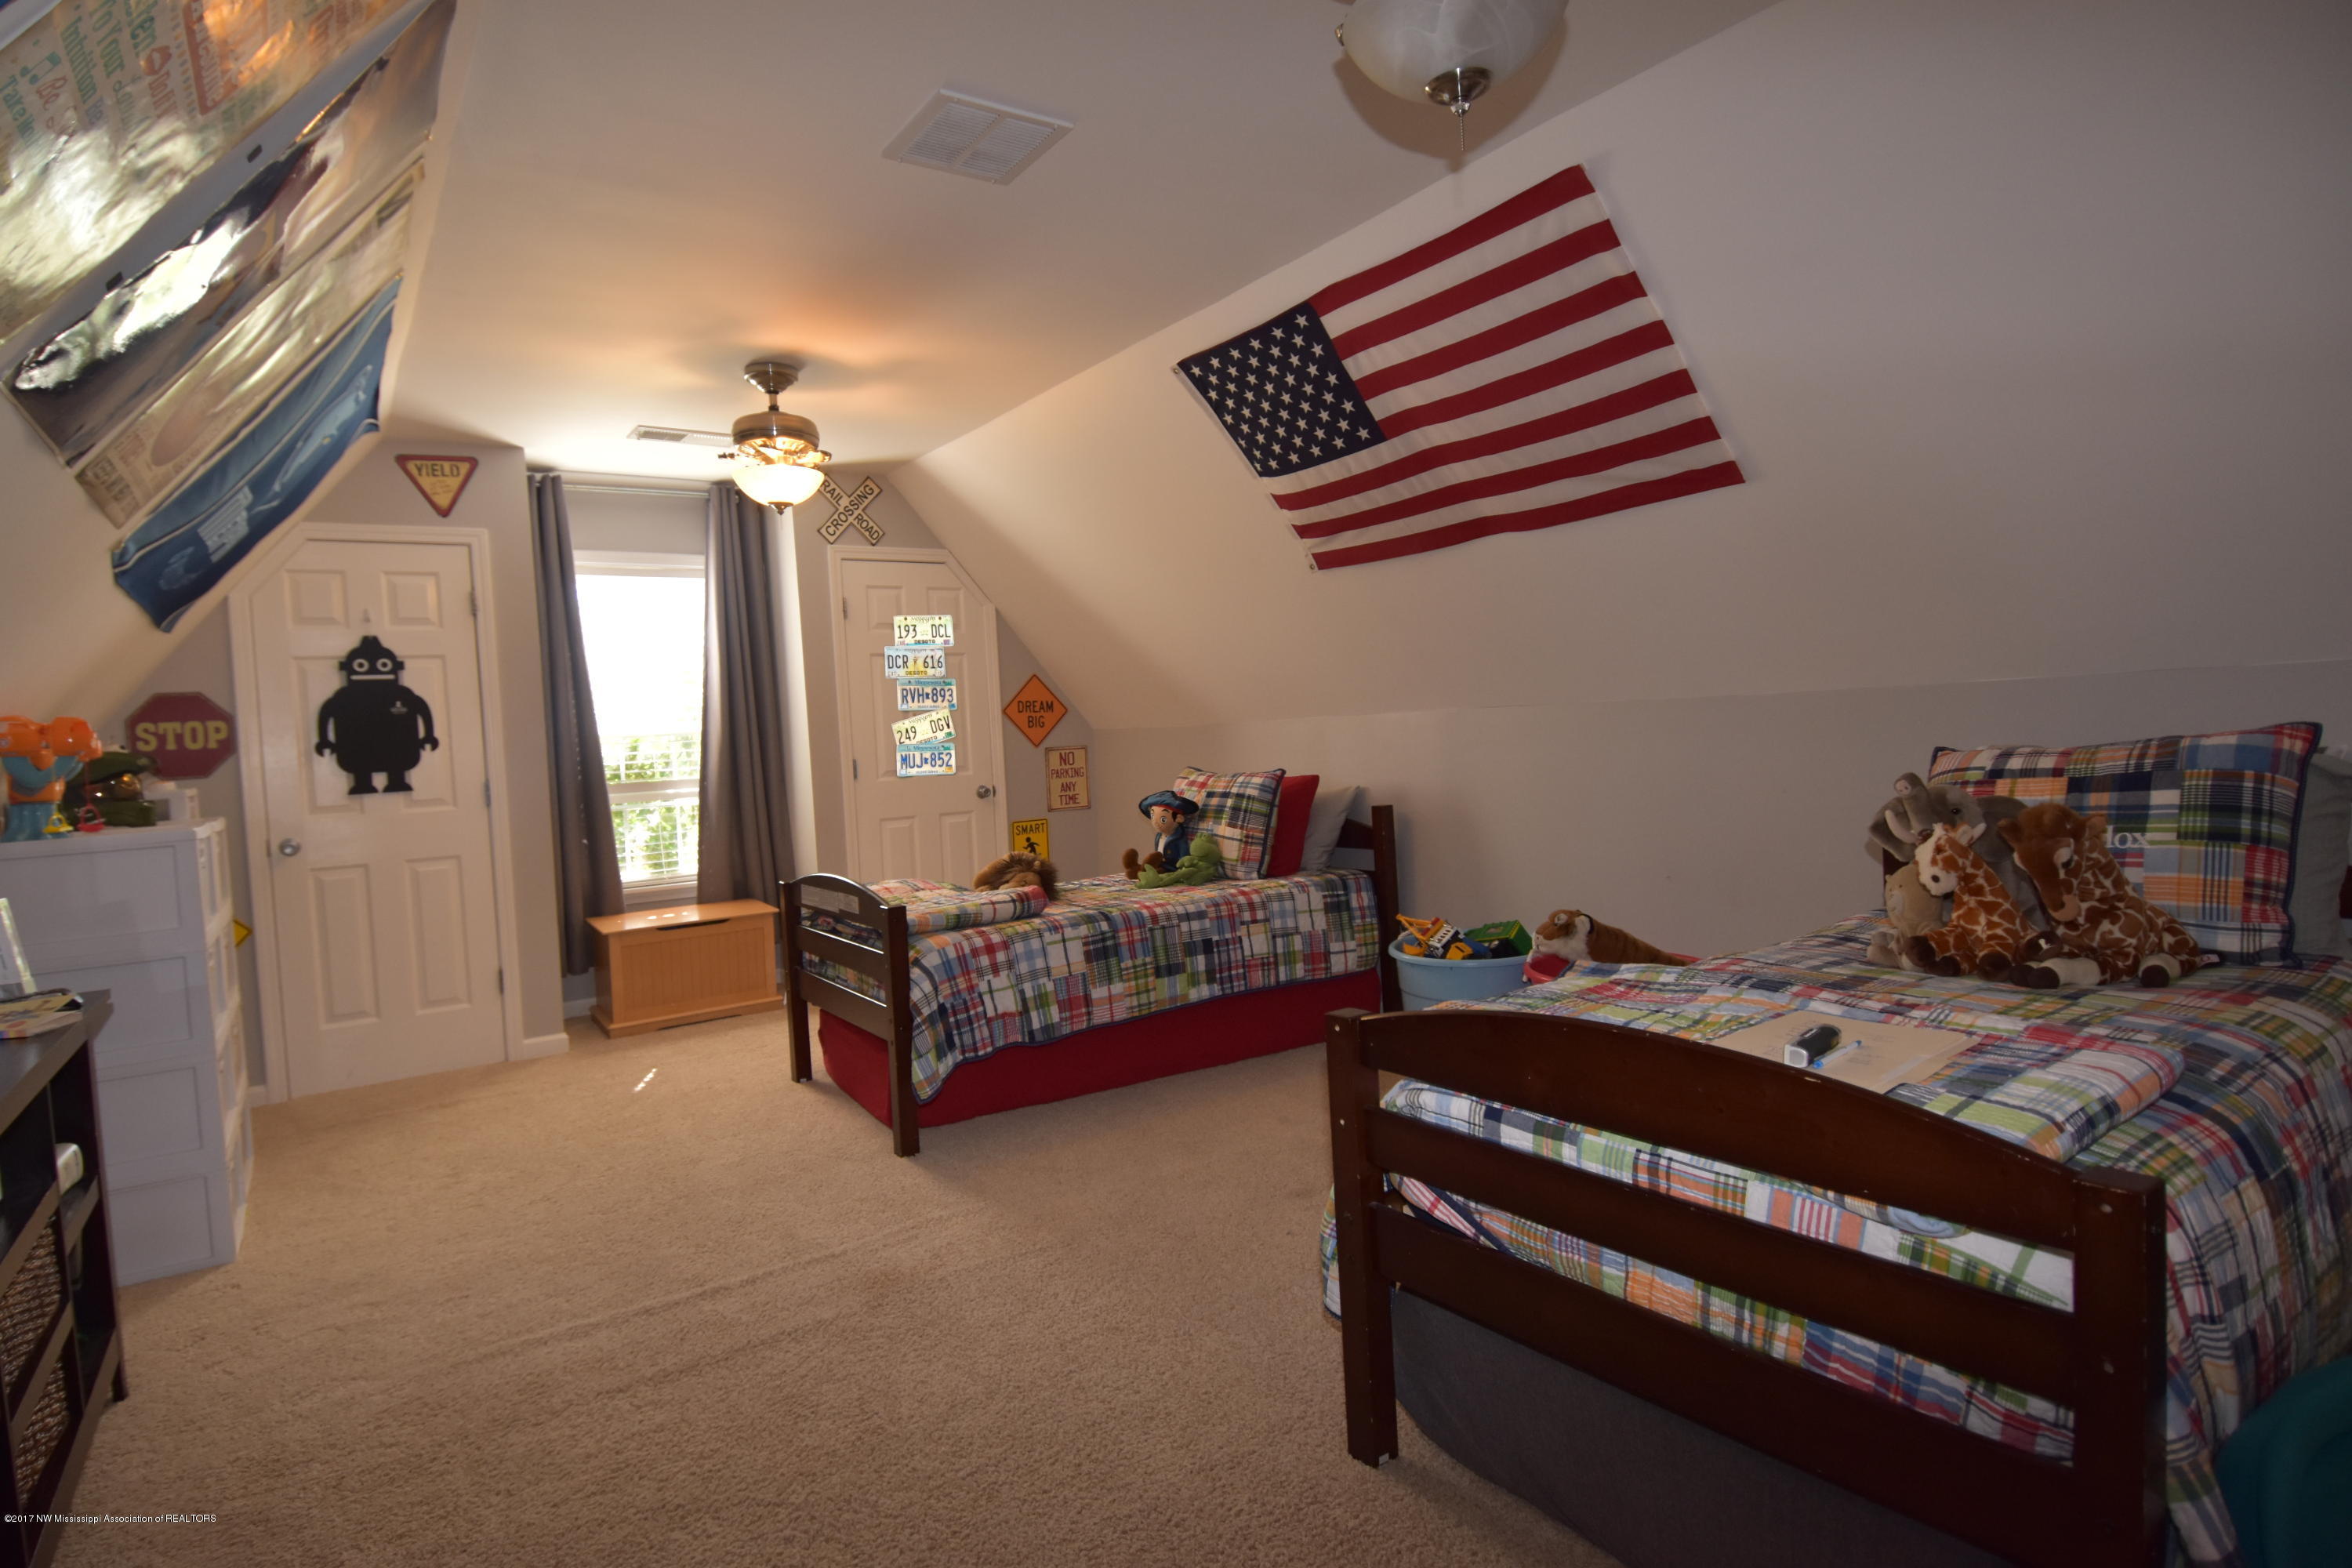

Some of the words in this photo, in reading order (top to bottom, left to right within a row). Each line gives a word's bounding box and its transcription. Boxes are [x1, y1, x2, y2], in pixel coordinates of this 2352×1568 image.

[414, 463, 460, 477] YIELD
[821, 479, 844, 507] RAIL
[852, 513, 880, 541] ROAD
[825, 484, 875, 537] CROSSING
[897, 624, 917, 639] 193
[931, 623, 951, 638] DCL
[887, 655, 909, 670] DCR
[923, 655, 943, 669] 616
[901, 688, 925, 703] RVH
[931, 688, 954, 703] 893
[1017, 700, 1054, 713] DREAM
[1027, 715, 1045, 728] BIG
[136, 720, 228, 752] STOP
[896, 725, 917, 745] 249
[929, 715, 951, 734] DGV
[900, 753, 923, 769] MUJ
[930, 752, 953, 768] 852
[1059, 751, 1075, 766] NO
[1051, 766, 1085, 779] PARKING
[1060, 781, 1076, 793] ANY
[1058, 793, 1080, 806] TIME
[1015, 822, 1045, 836] SMART
